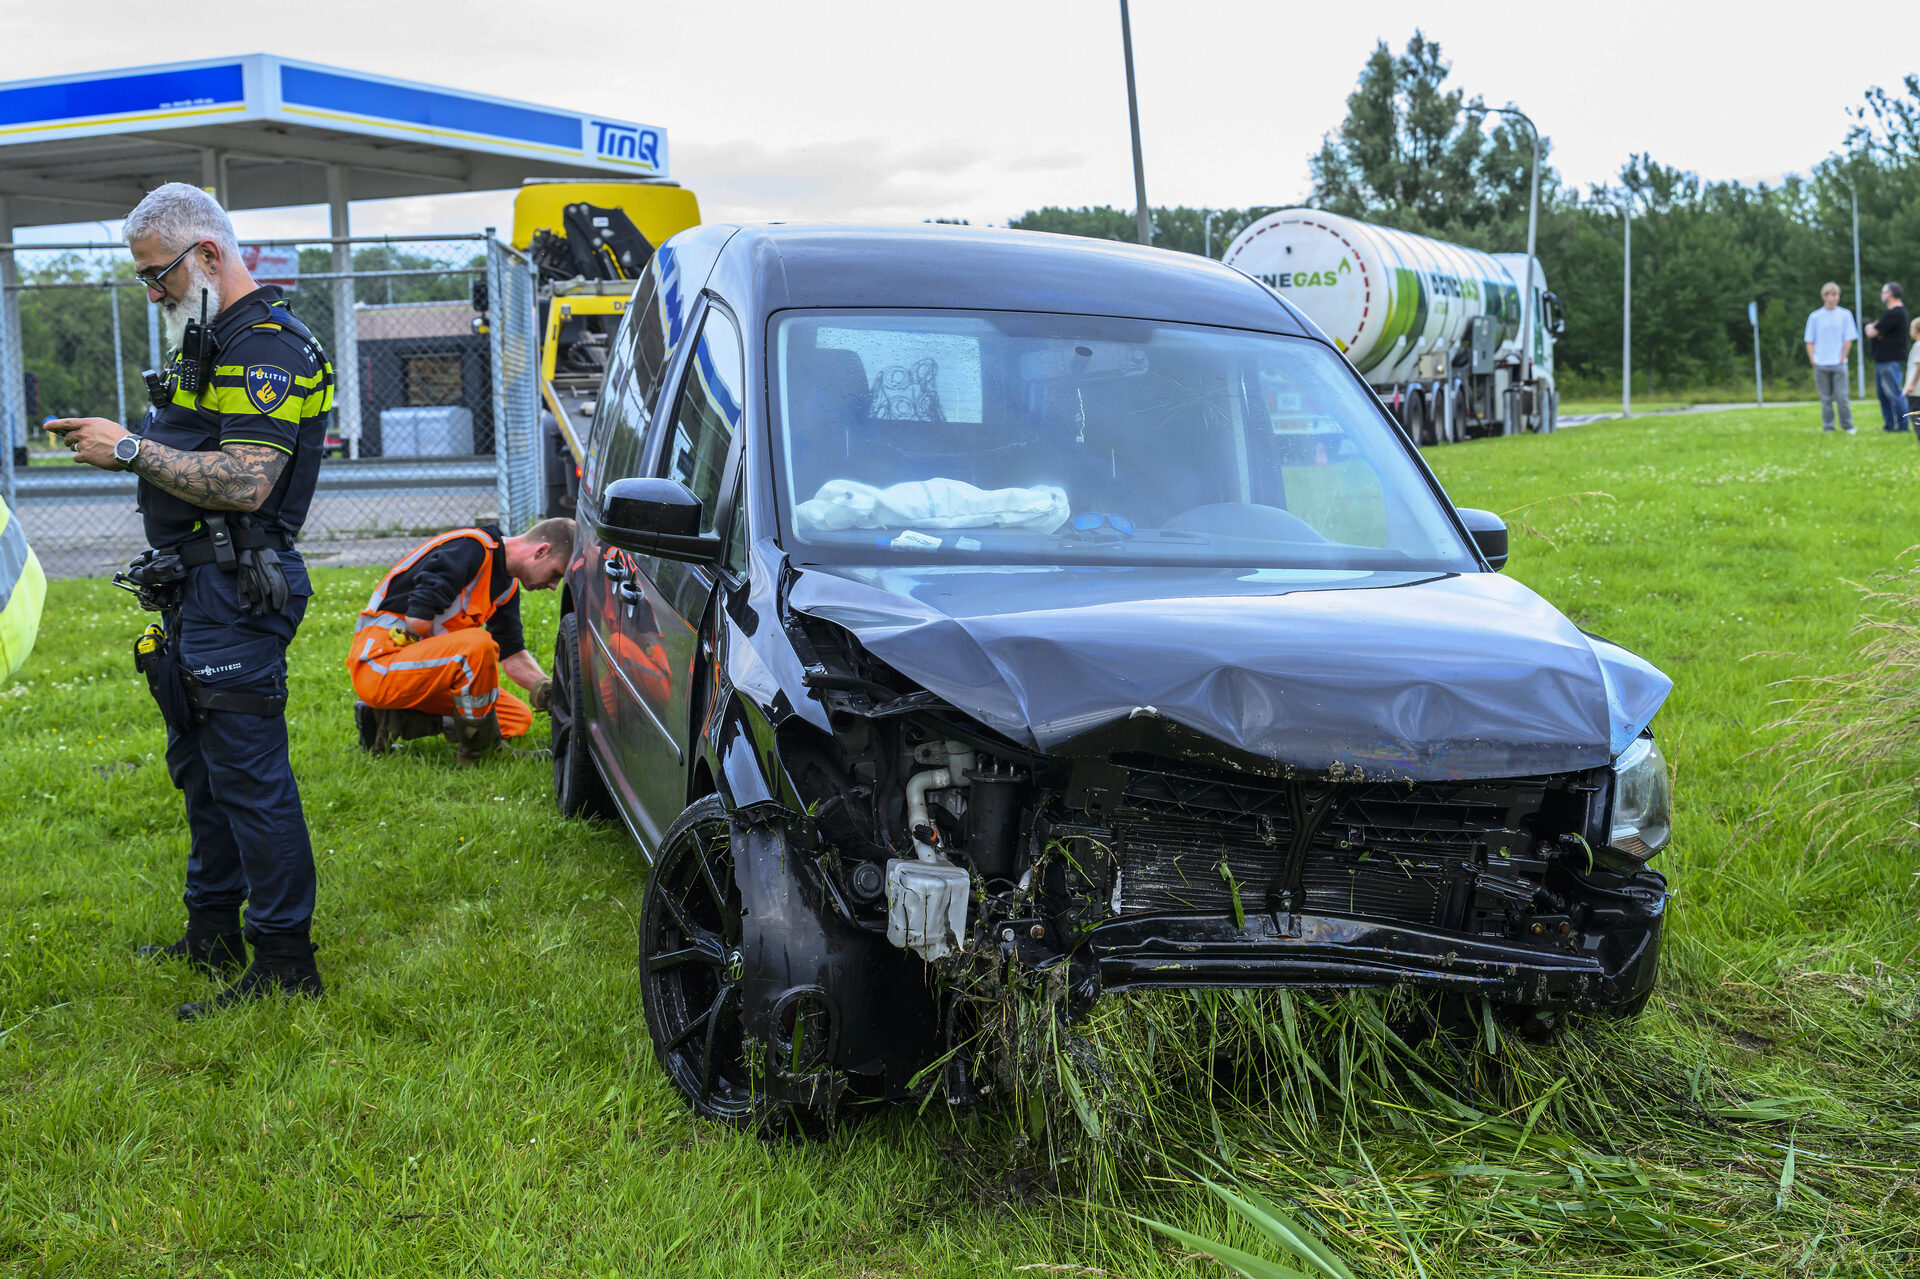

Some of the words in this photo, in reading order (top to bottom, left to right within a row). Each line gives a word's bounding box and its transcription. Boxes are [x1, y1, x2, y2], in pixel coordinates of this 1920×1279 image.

[1255, 270, 1337, 288] NEGAS
[250, 370, 287, 382] POLITIE
[200, 664, 234, 676] POLITIE
